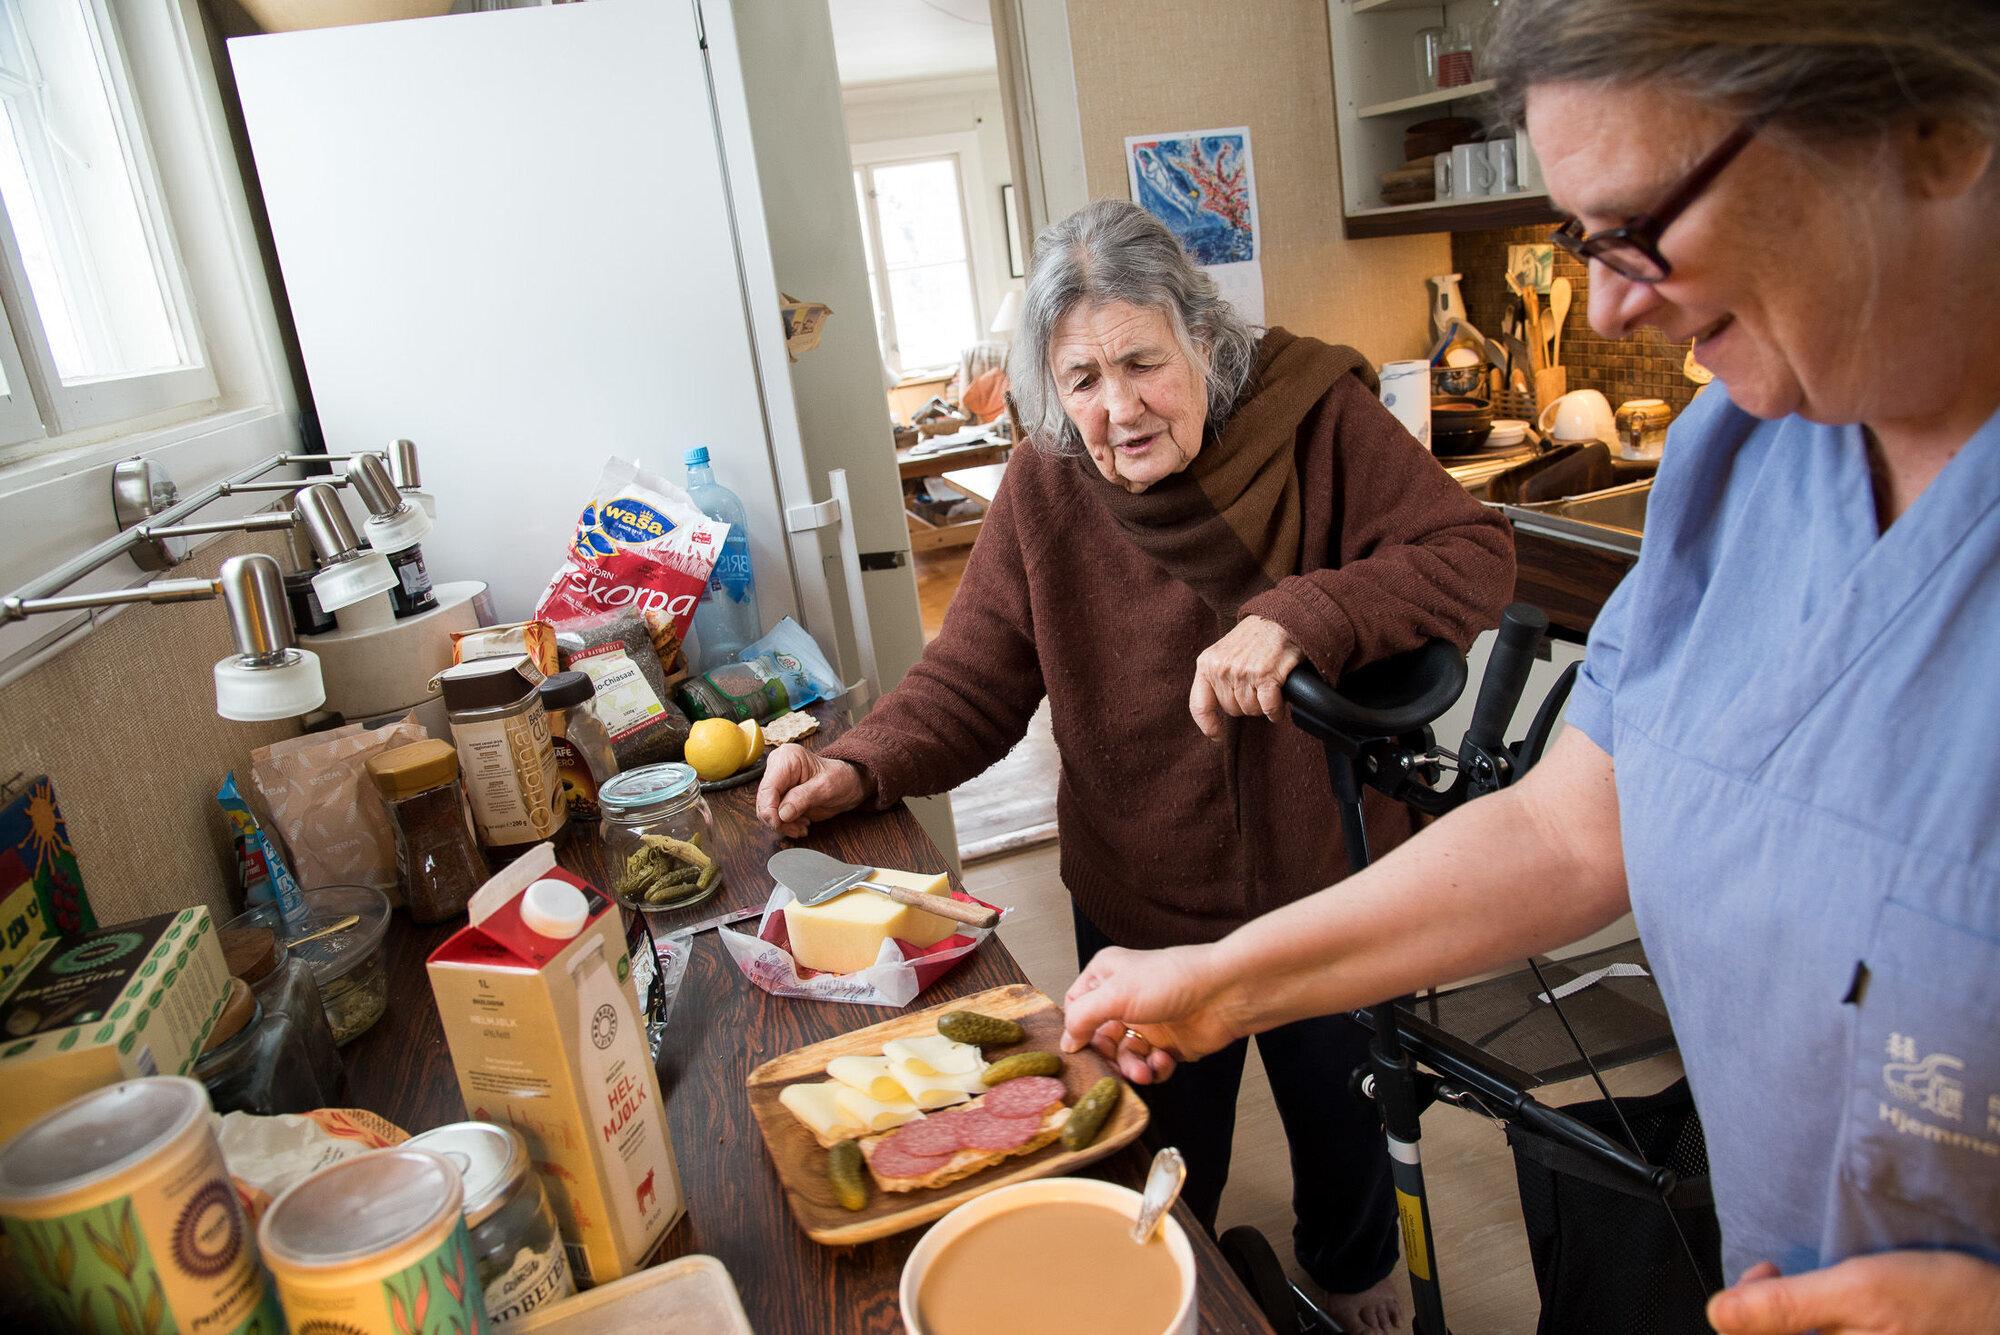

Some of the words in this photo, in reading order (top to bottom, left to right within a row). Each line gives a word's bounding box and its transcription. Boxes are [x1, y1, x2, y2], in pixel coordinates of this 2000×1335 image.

[606, 505, 663, 536] wasa
[569, 573, 697, 618] skorpa
[595, 670, 635, 692] io-Chiasaat
[528, 703, 545, 726] BARLE
[507, 722, 551, 829] Original
[608, 1074, 637, 1111] HEL-
[603, 1082, 647, 1143] MJØLK
